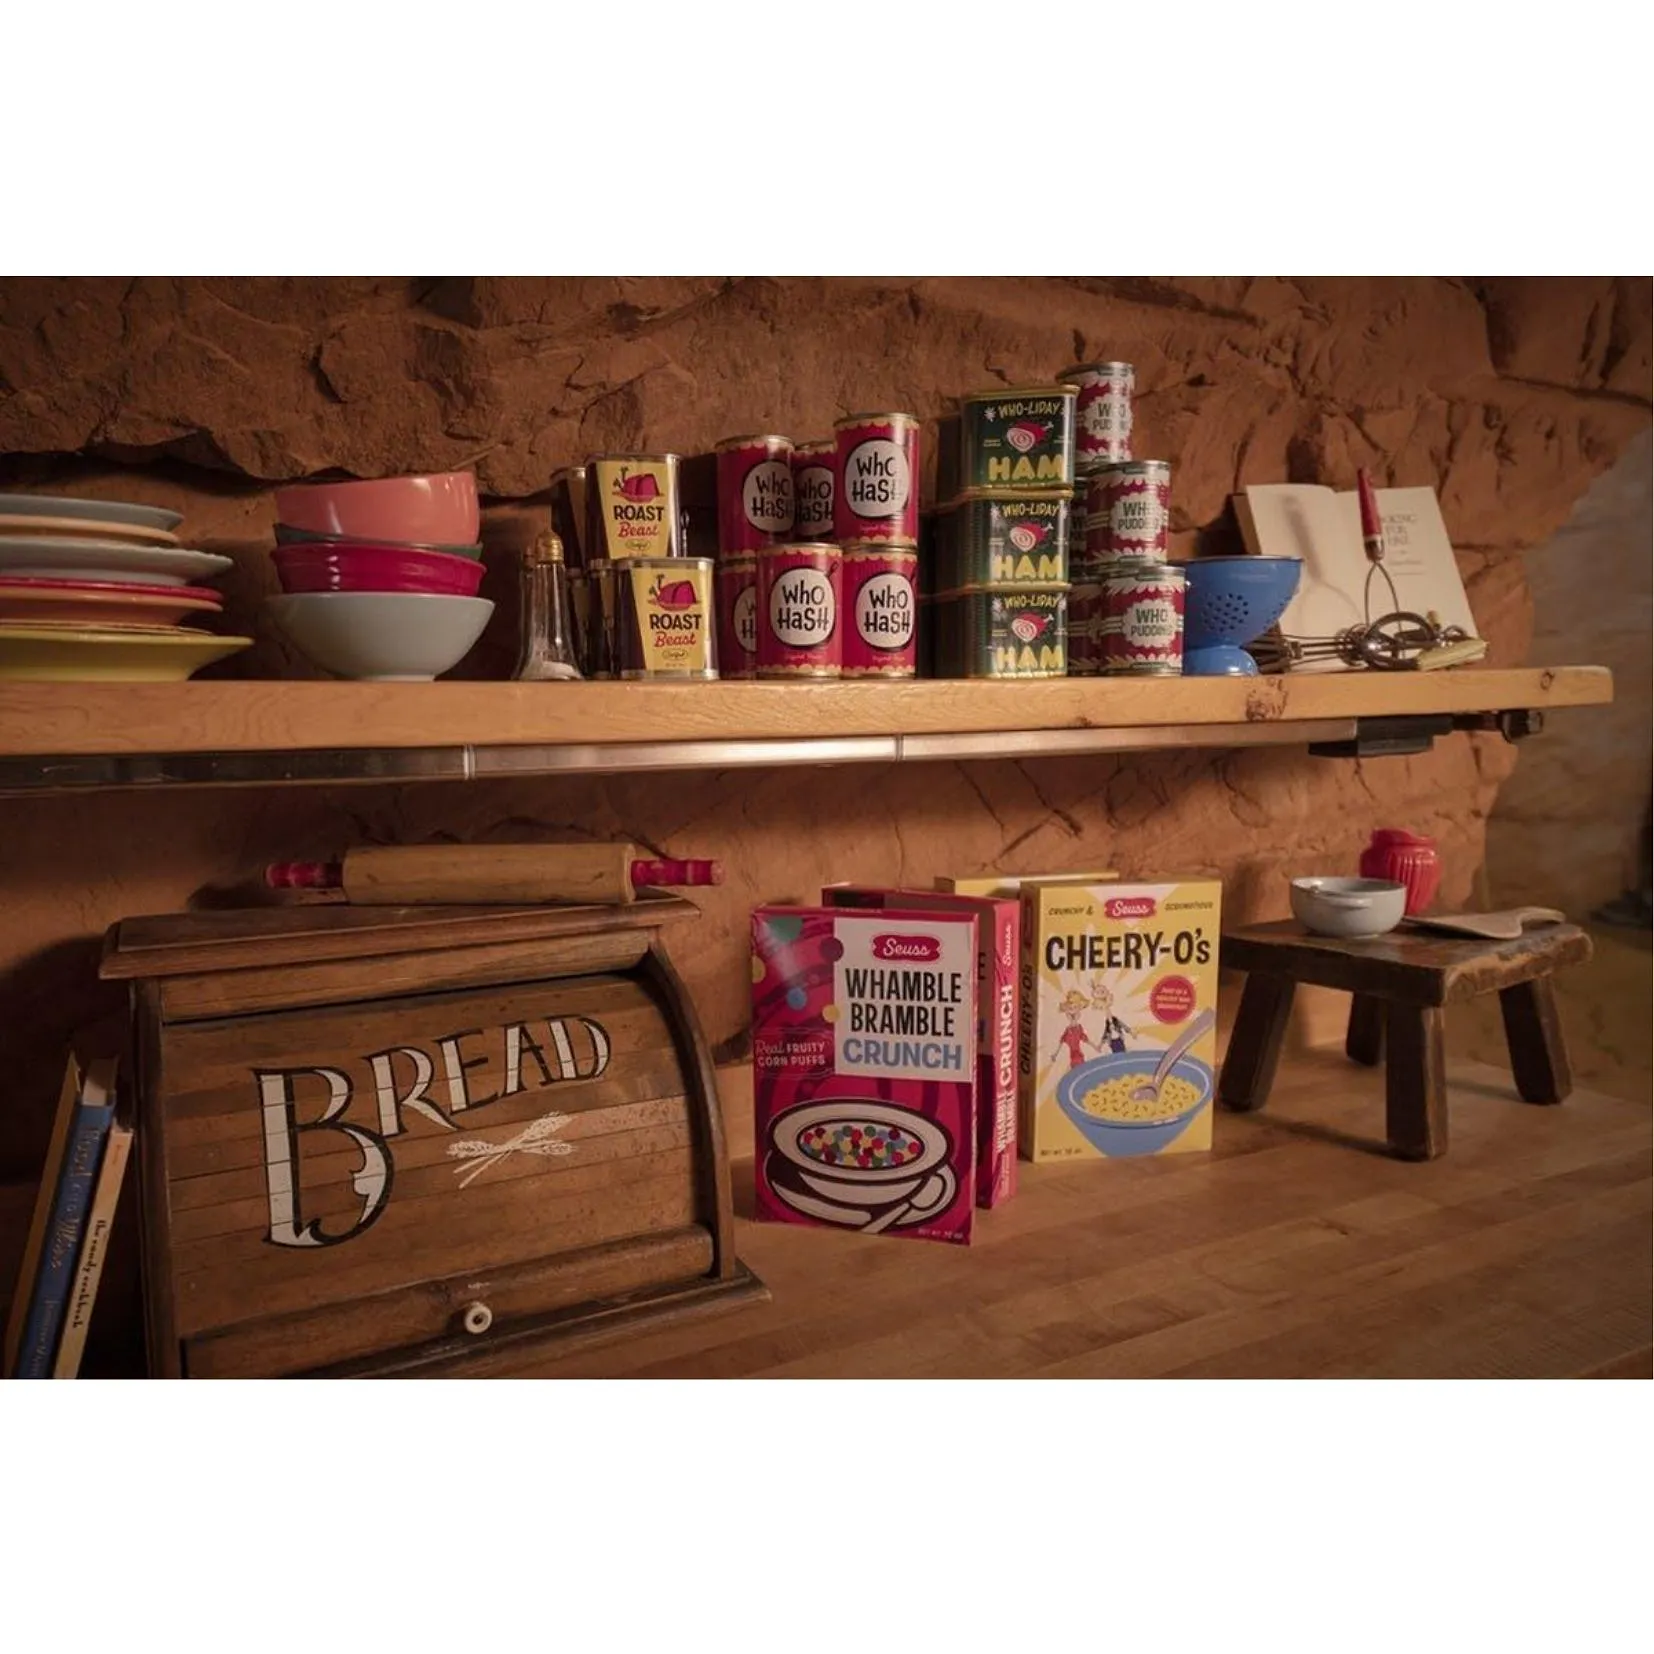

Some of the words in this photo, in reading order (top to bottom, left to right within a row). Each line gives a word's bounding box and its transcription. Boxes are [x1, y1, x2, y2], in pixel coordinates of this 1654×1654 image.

[998, 401, 1061, 419] WHO-LIDAY
[988, 454, 1064, 482] HAM
[613, 505, 665, 522] ROAST
[1002, 503, 1059, 518] WHO-LIDAY
[617, 521, 660, 538] Beast
[993, 554, 1063, 580] HAM
[1004, 594, 1059, 609] WHO-LIDAY
[649, 613, 702, 630] ROAST
[1136, 608, 1168, 623] WHO
[654, 631, 697, 647] Beast
[996, 645, 1064, 670] HAM
[1112, 900, 1150, 917] Seuss
[882, 938, 931, 957] Seuss
[844, 967, 962, 1004] WHAMBLE
[851, 1002, 955, 1037] BRAMBLE
[999, 984, 1015, 1086] CRUNCH
[786, 1042, 825, 1053] FRUITY
[843, 1038, 963, 1070] CRUNCH
[758, 1055, 788, 1067] CORN
[790, 1054, 826, 1066] PUFFS
